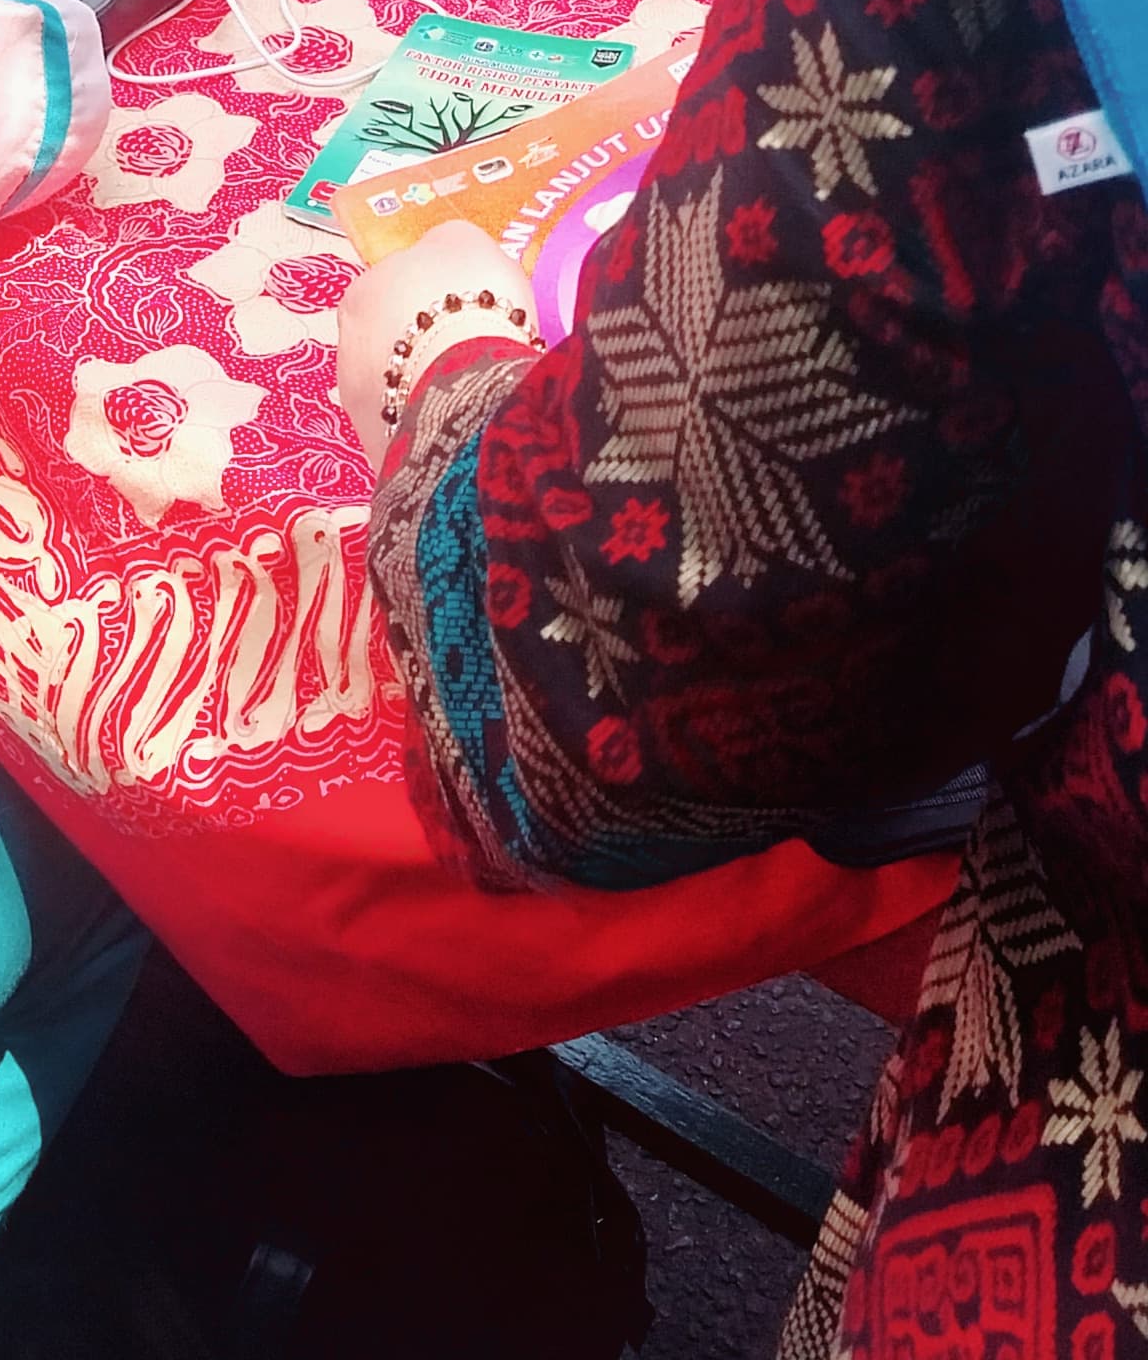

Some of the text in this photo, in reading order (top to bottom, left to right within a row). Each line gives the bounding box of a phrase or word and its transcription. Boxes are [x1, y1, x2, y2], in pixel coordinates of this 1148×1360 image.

[404, 50, 597, 92] FAKTOR RISIKO PENYAKIT
[417, 66, 577, 104] TIDAK MENULAR
[1058, 154, 1116, 182] AZARA
[499, 219, 536, 261] AN
[520, 132, 629, 219] LANJUT
